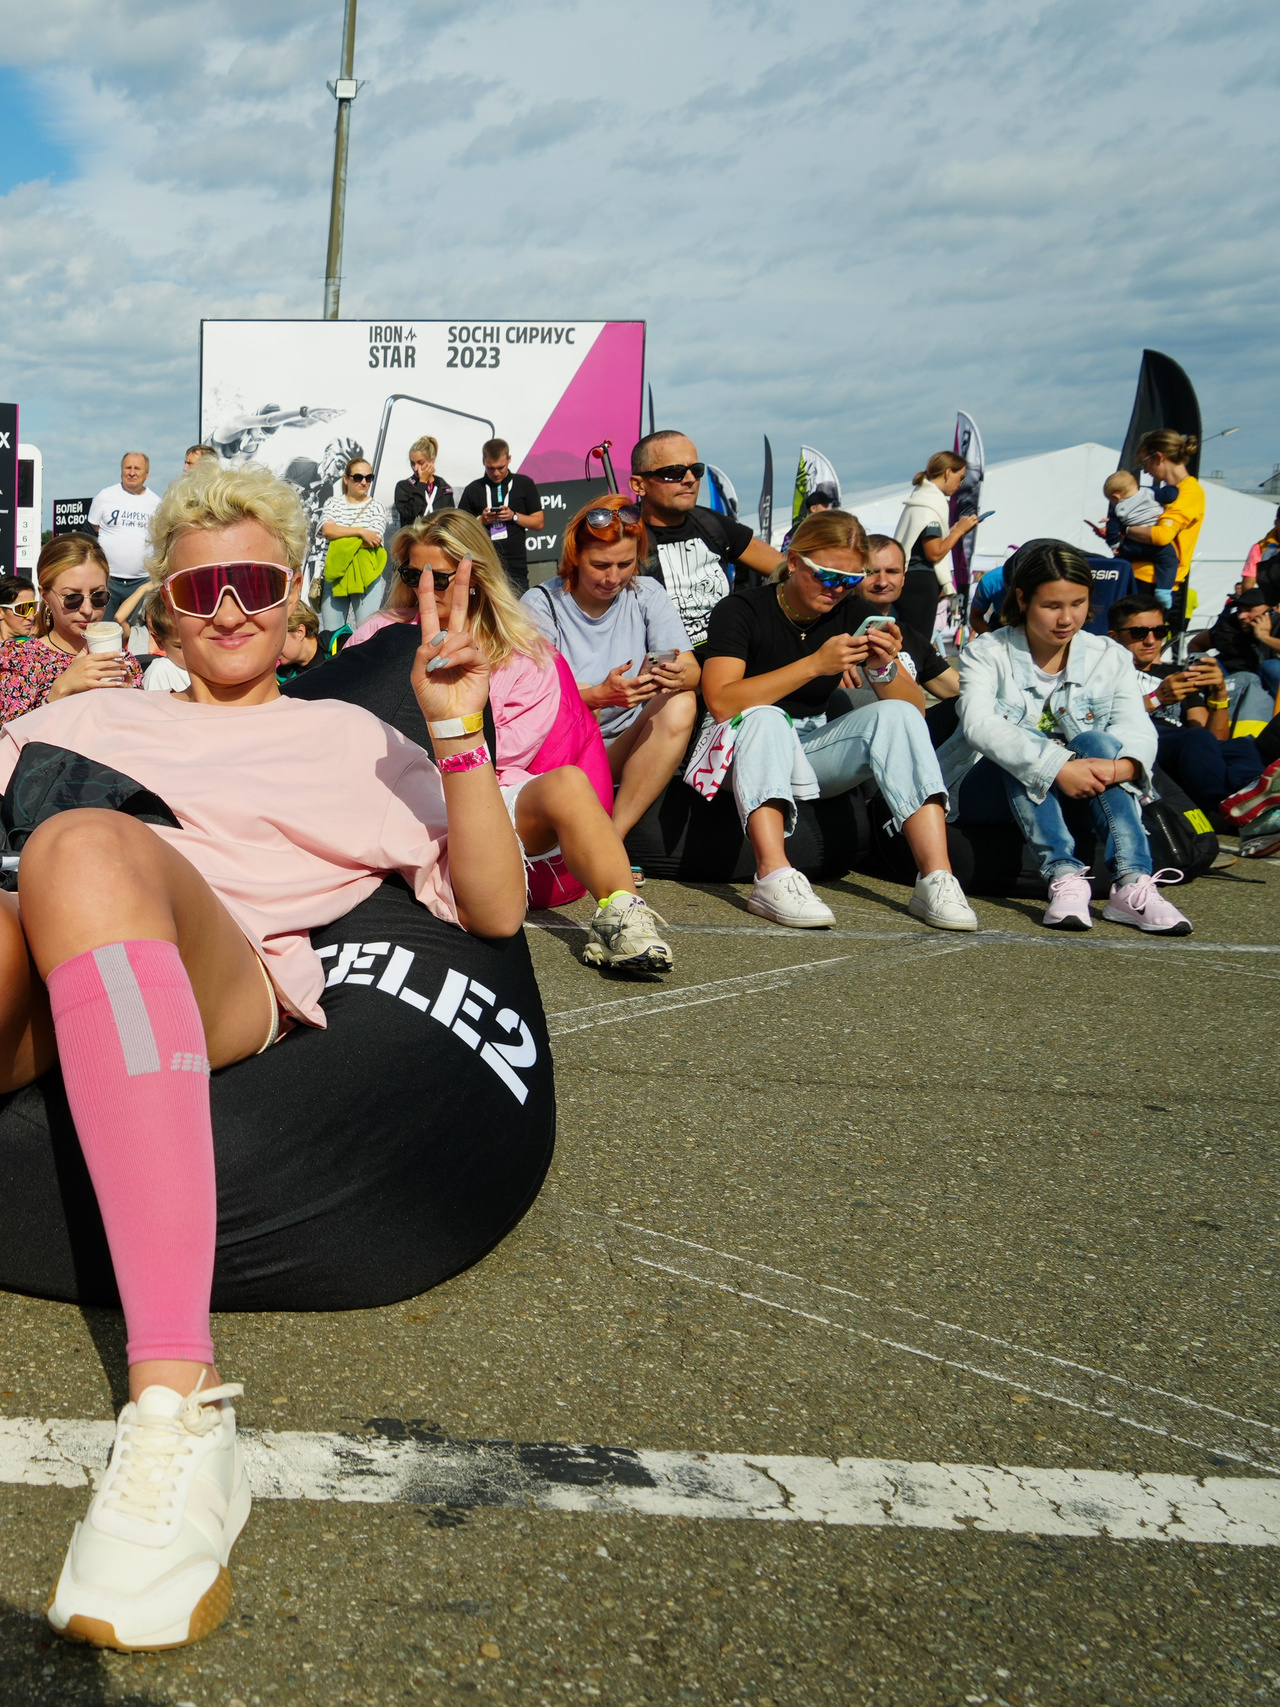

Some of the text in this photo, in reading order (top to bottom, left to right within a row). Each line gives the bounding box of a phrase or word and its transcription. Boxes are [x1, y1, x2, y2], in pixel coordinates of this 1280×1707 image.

[369, 325, 403, 343] IRON
[448, 325, 501, 344] SOCHI
[505, 327, 576, 345] СИРИУС
[369, 345, 416, 368] STAR
[446, 346, 501, 369] 2023
[55, 501, 83, 514] БОЛЕЙ
[540, 495, 567, 509] РИ,
[55, 515, 66, 525] ЗА
[107, 510, 120, 525] Я
[525, 535, 557, 550] ОГУ
